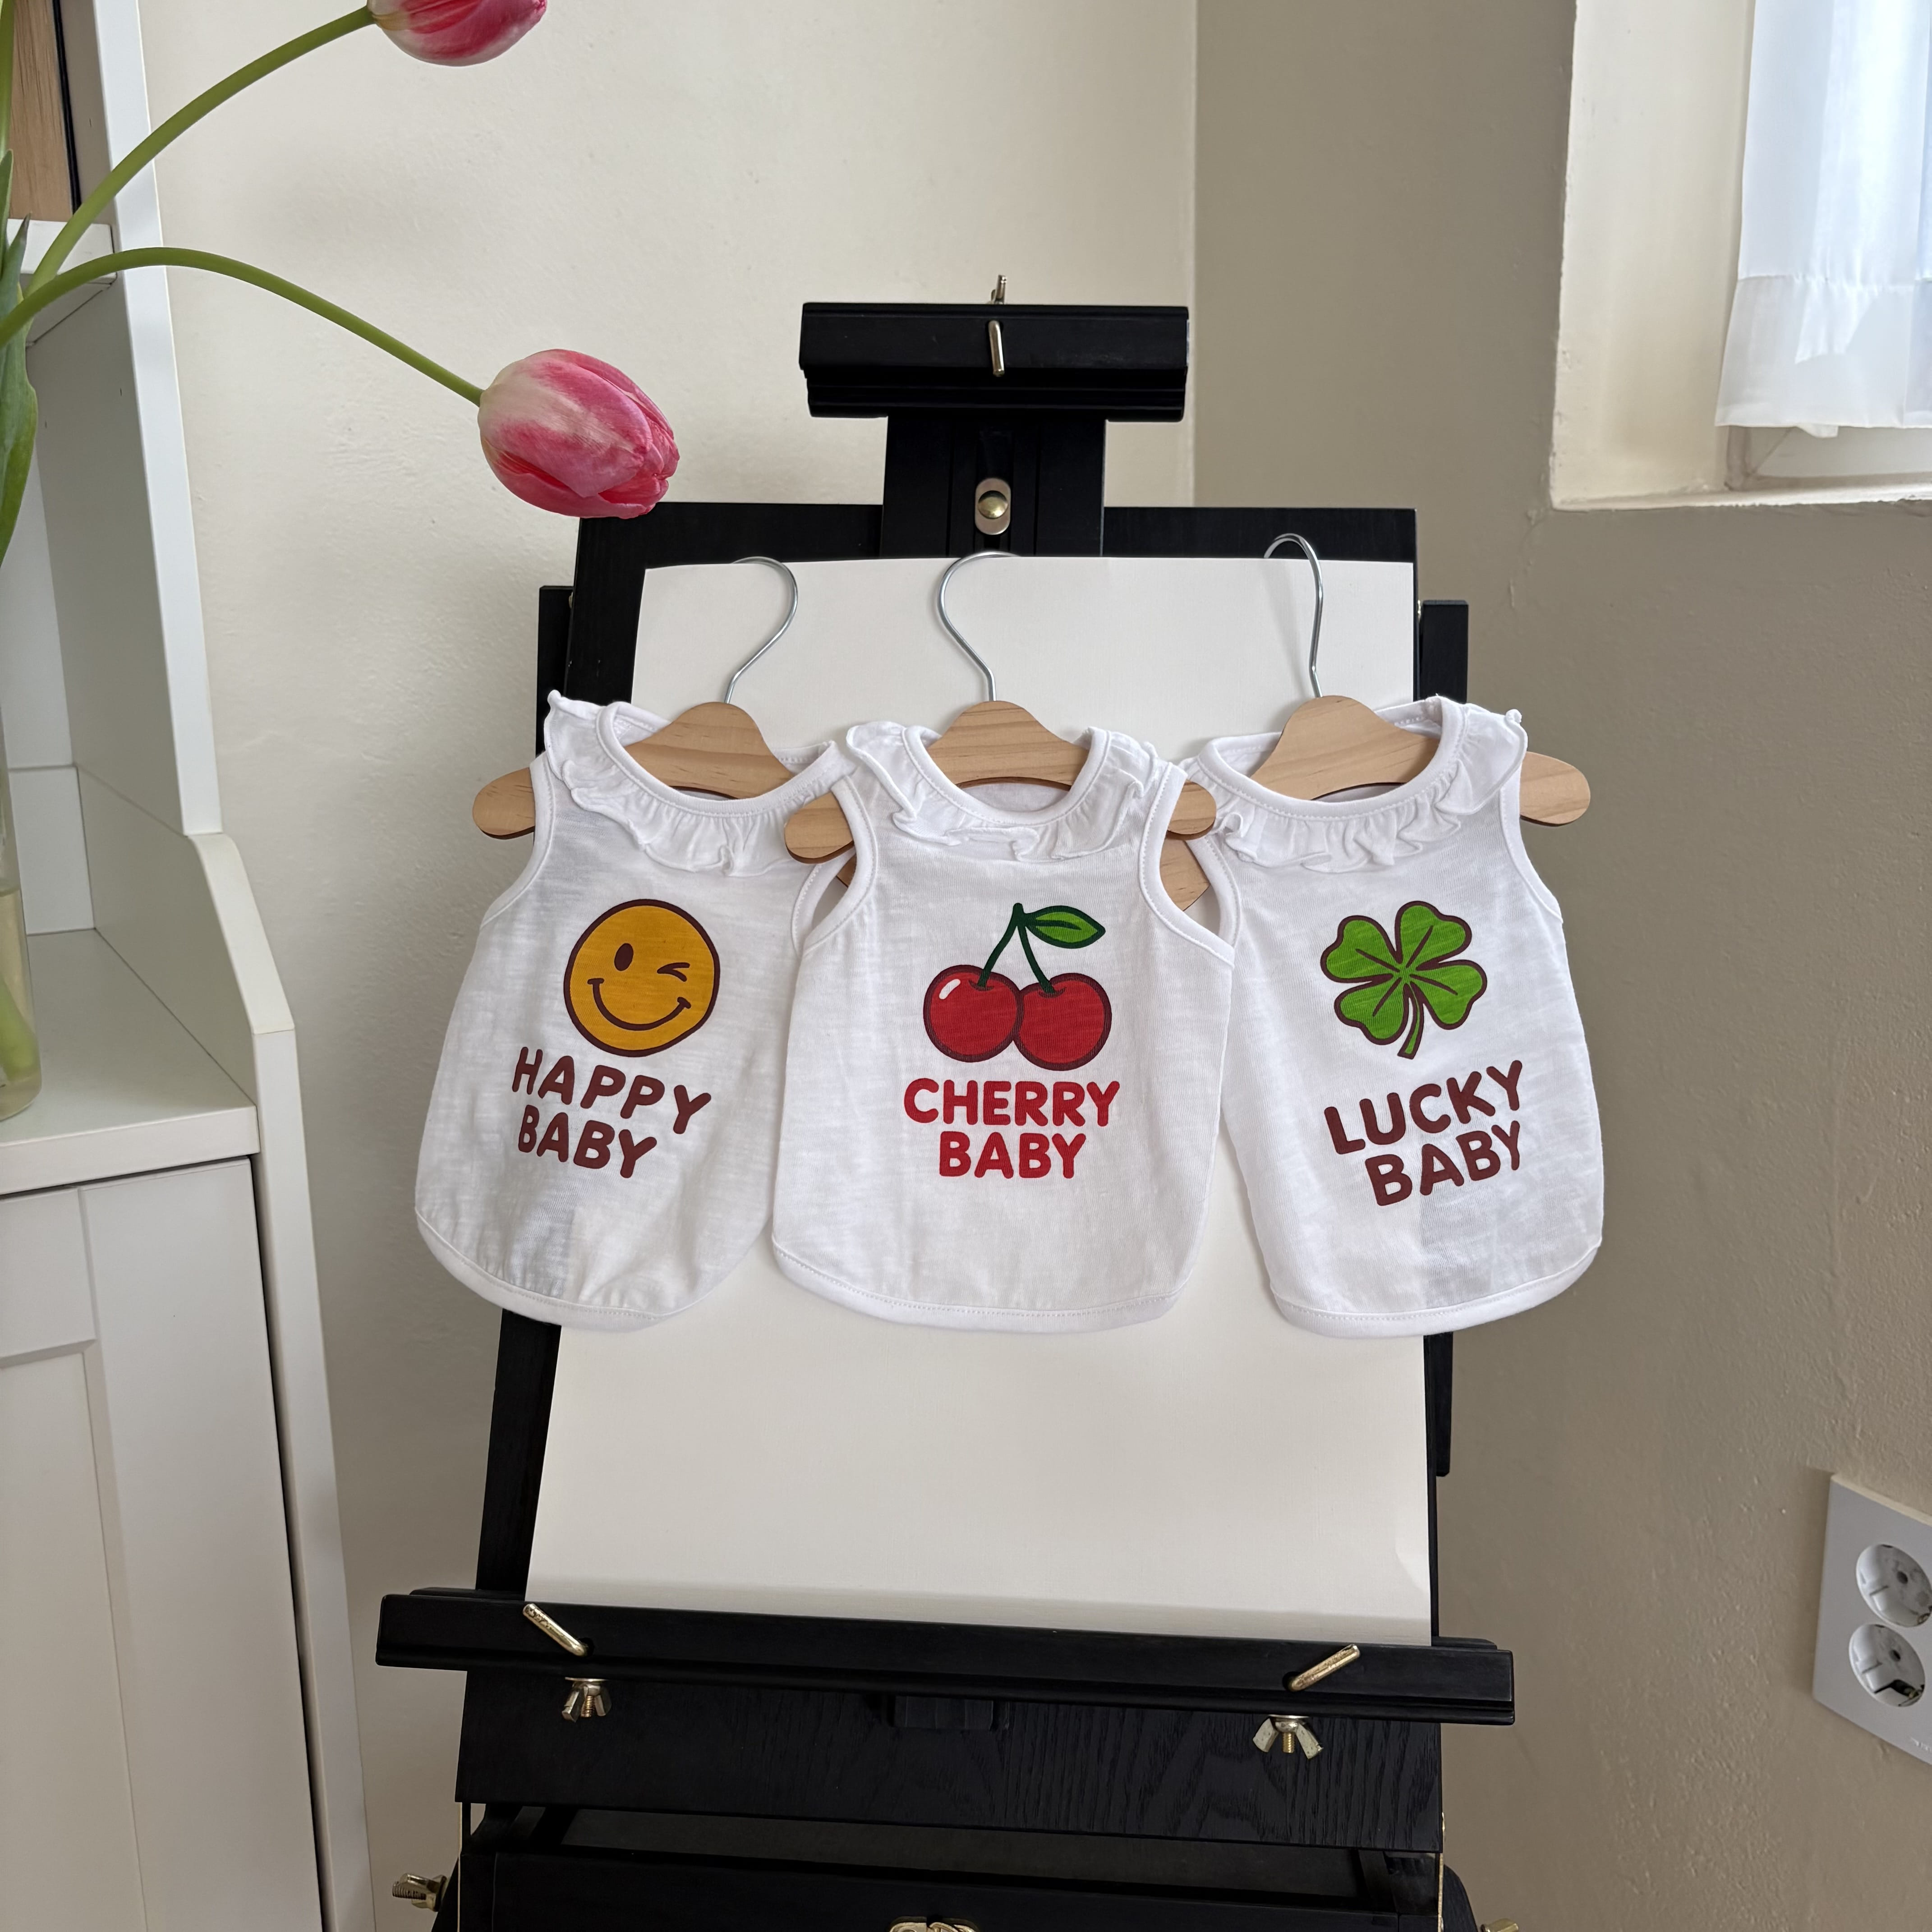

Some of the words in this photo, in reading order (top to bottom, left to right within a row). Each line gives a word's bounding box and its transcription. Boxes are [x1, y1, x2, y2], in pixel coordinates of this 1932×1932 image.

[512, 1047, 711, 1134] HAPPY
[904, 1078, 1120, 1127] CHERRY
[1325, 1061, 1522, 1155] LUCKY
[519, 1105, 657, 1178] BABY
[939, 1131, 1086, 1179] BABY
[1366, 1121, 1520, 1206] BABY
